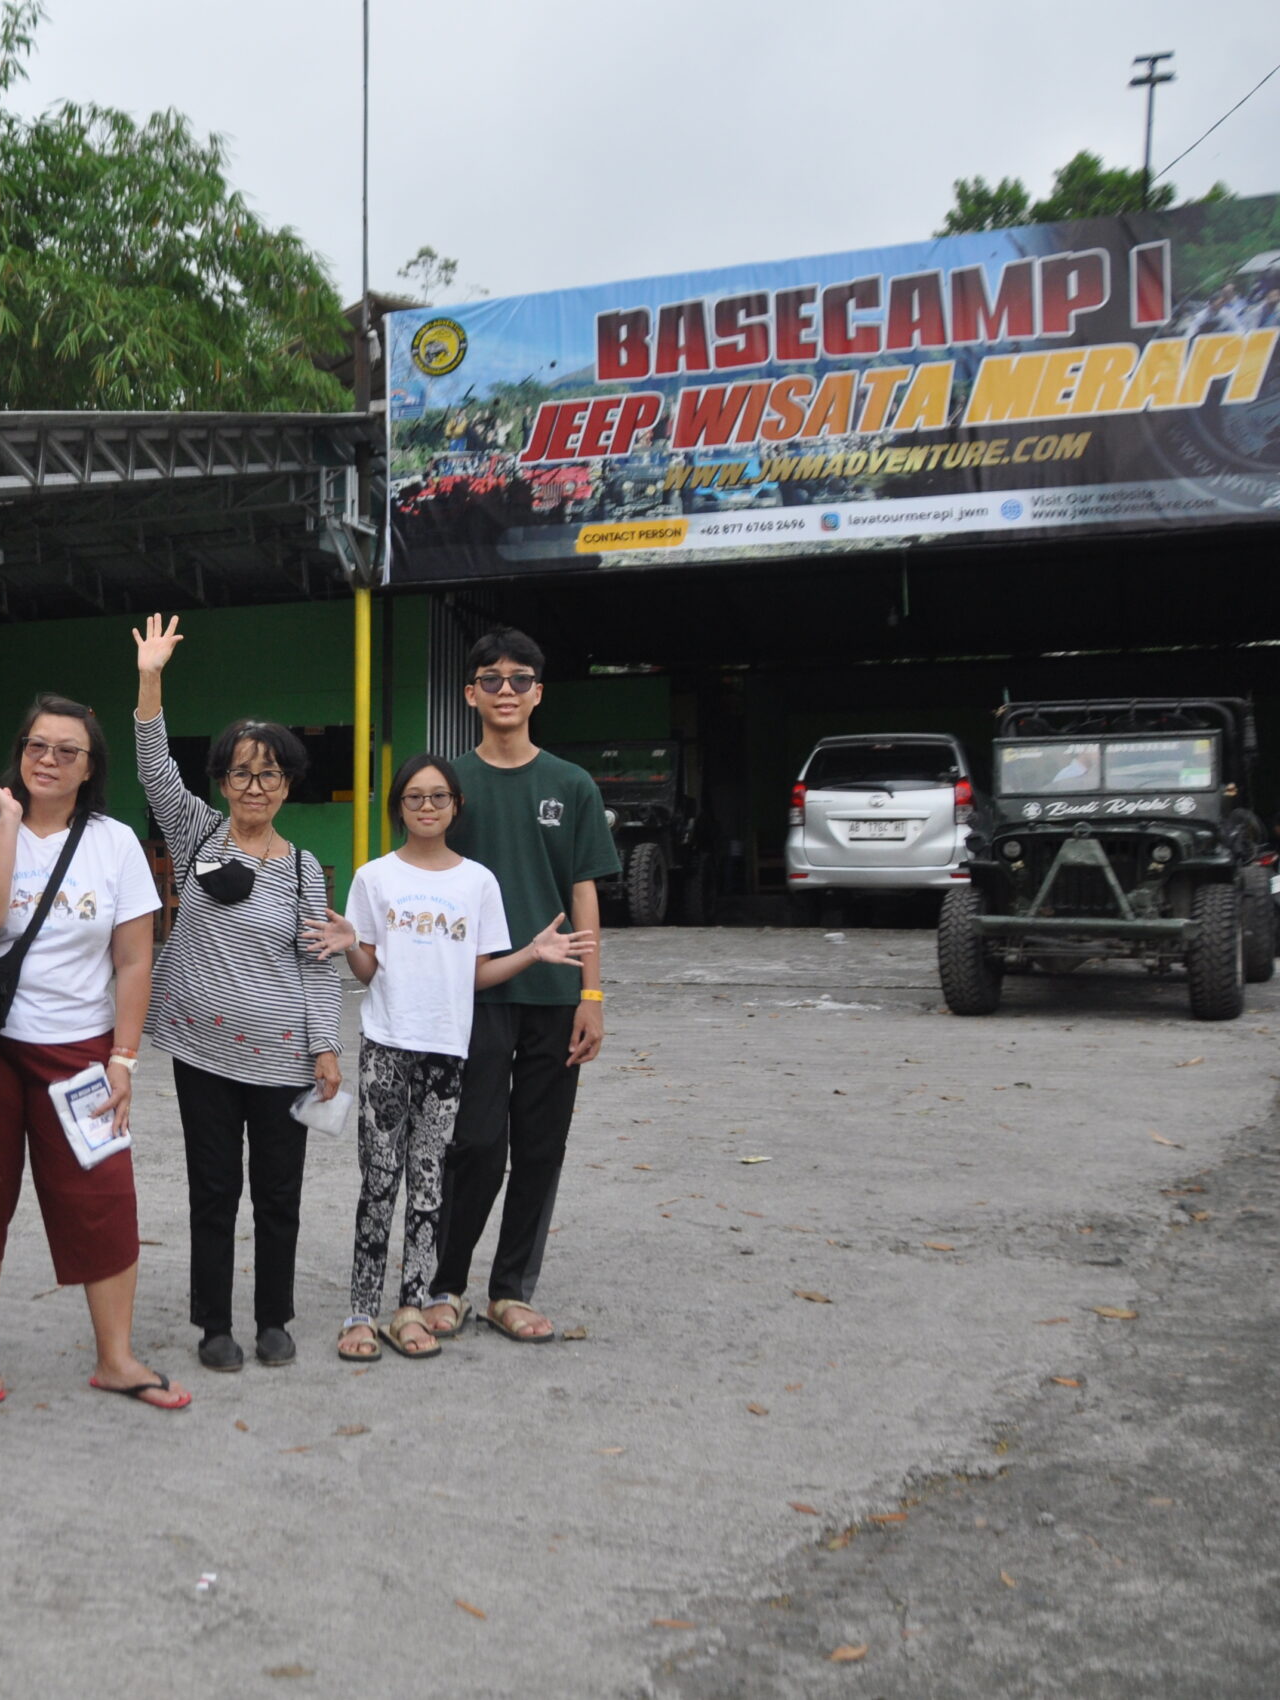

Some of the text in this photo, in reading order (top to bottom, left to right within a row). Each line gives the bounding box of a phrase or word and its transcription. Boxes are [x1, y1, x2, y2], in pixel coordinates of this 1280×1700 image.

[595, 248, 1110, 384] BASECAMP
[520, 326, 1279, 464] JEEP WISATA MERAPI
[663, 431, 1092, 490] WWW.JWMADVENTURE.COM
[583, 527, 682, 544] CONTACT PERSON
[700, 525, 719, 535] +62
[723, 522, 742, 533] 877
[1045, 800, 1100, 817] Budi
